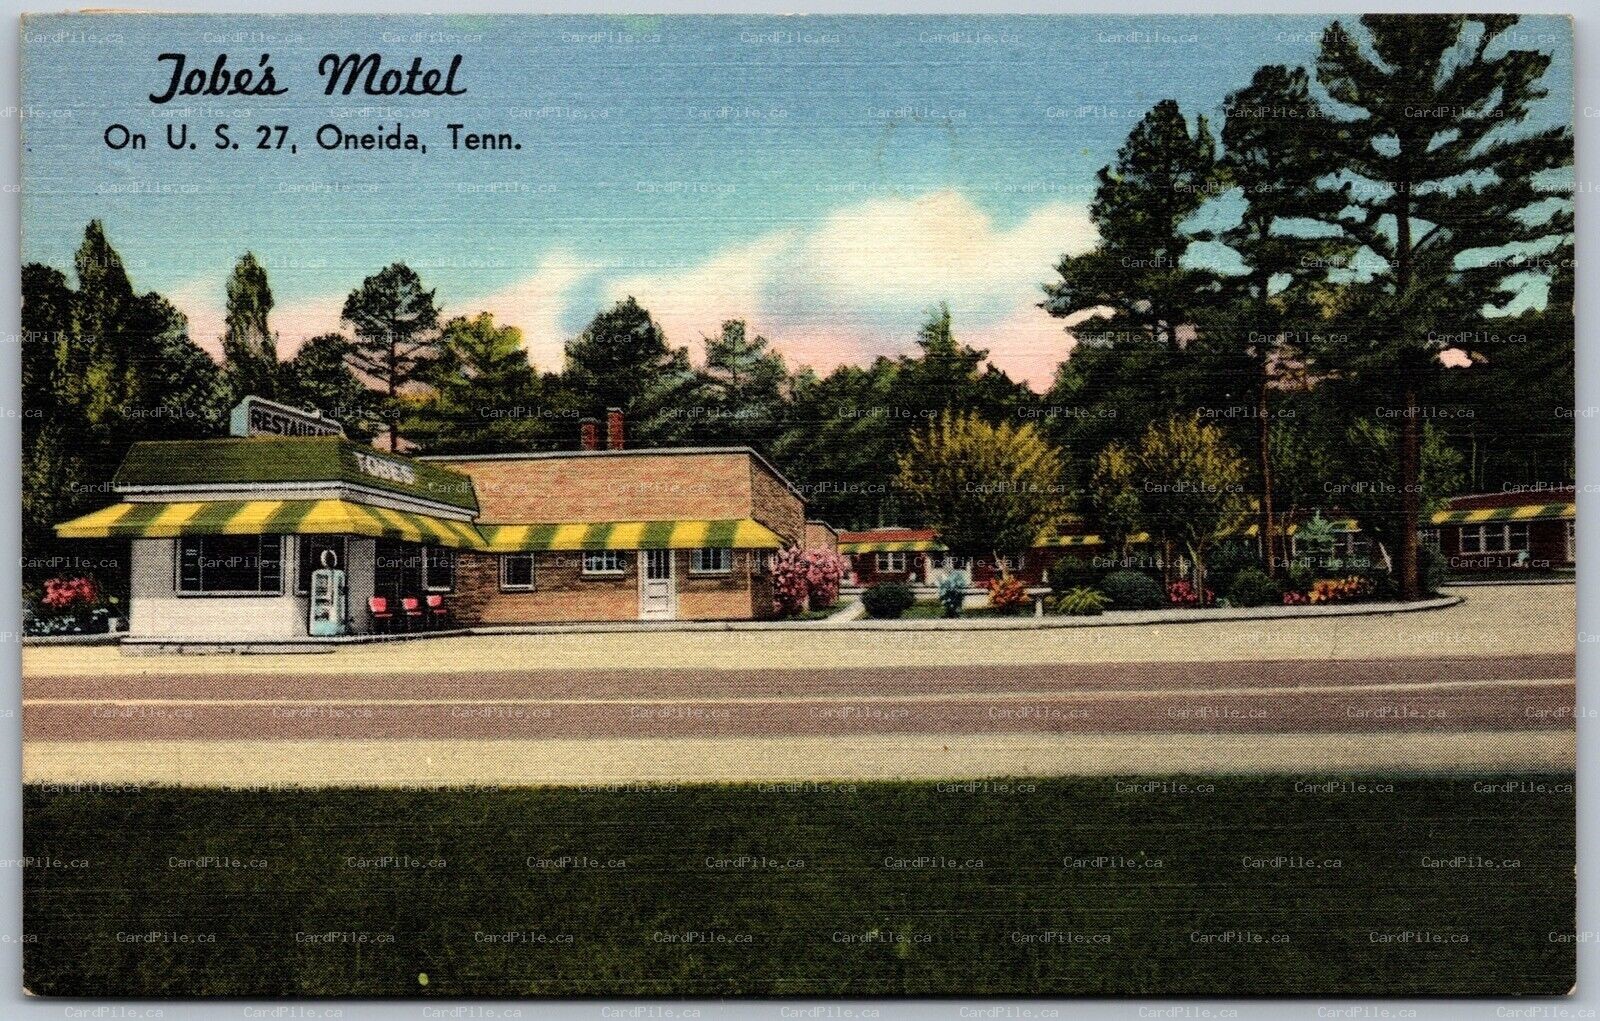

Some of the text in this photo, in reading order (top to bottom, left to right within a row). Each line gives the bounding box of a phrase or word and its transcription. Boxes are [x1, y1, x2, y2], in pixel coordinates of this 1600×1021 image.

[319, 53, 467, 95] Motel
[104, 123, 521, 154] On U. S. 27, Oneida, Tenn.
